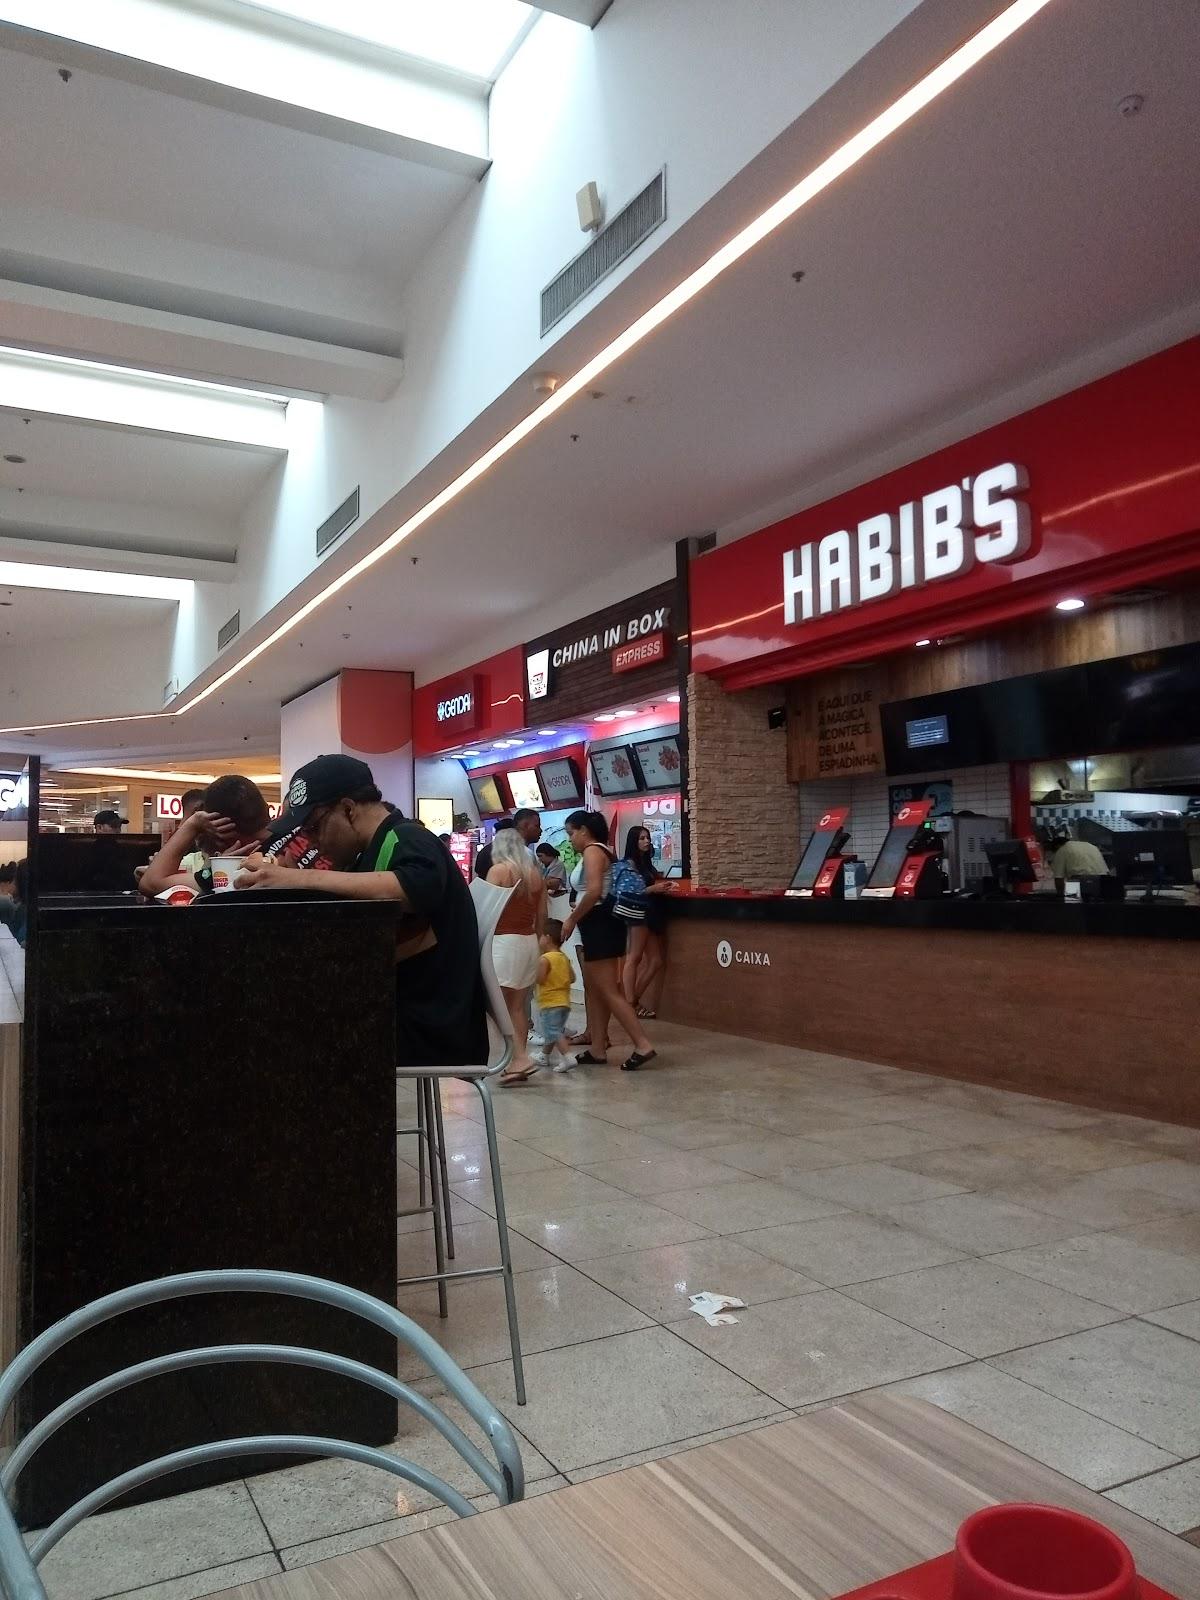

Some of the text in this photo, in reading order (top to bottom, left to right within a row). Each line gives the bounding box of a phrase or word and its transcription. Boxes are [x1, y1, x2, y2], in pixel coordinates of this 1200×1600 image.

[783, 462, 1020, 625] HABIB'S
[552, 607, 665, 668] CHINA IN BOX
[615, 640, 661, 667] EXPRESS
[444, 692, 471, 718] GENDAI
[825, 695, 848, 710] AQUI
[833, 741, 856, 755] UMA
[735, 950, 771, 966] CAIXA
